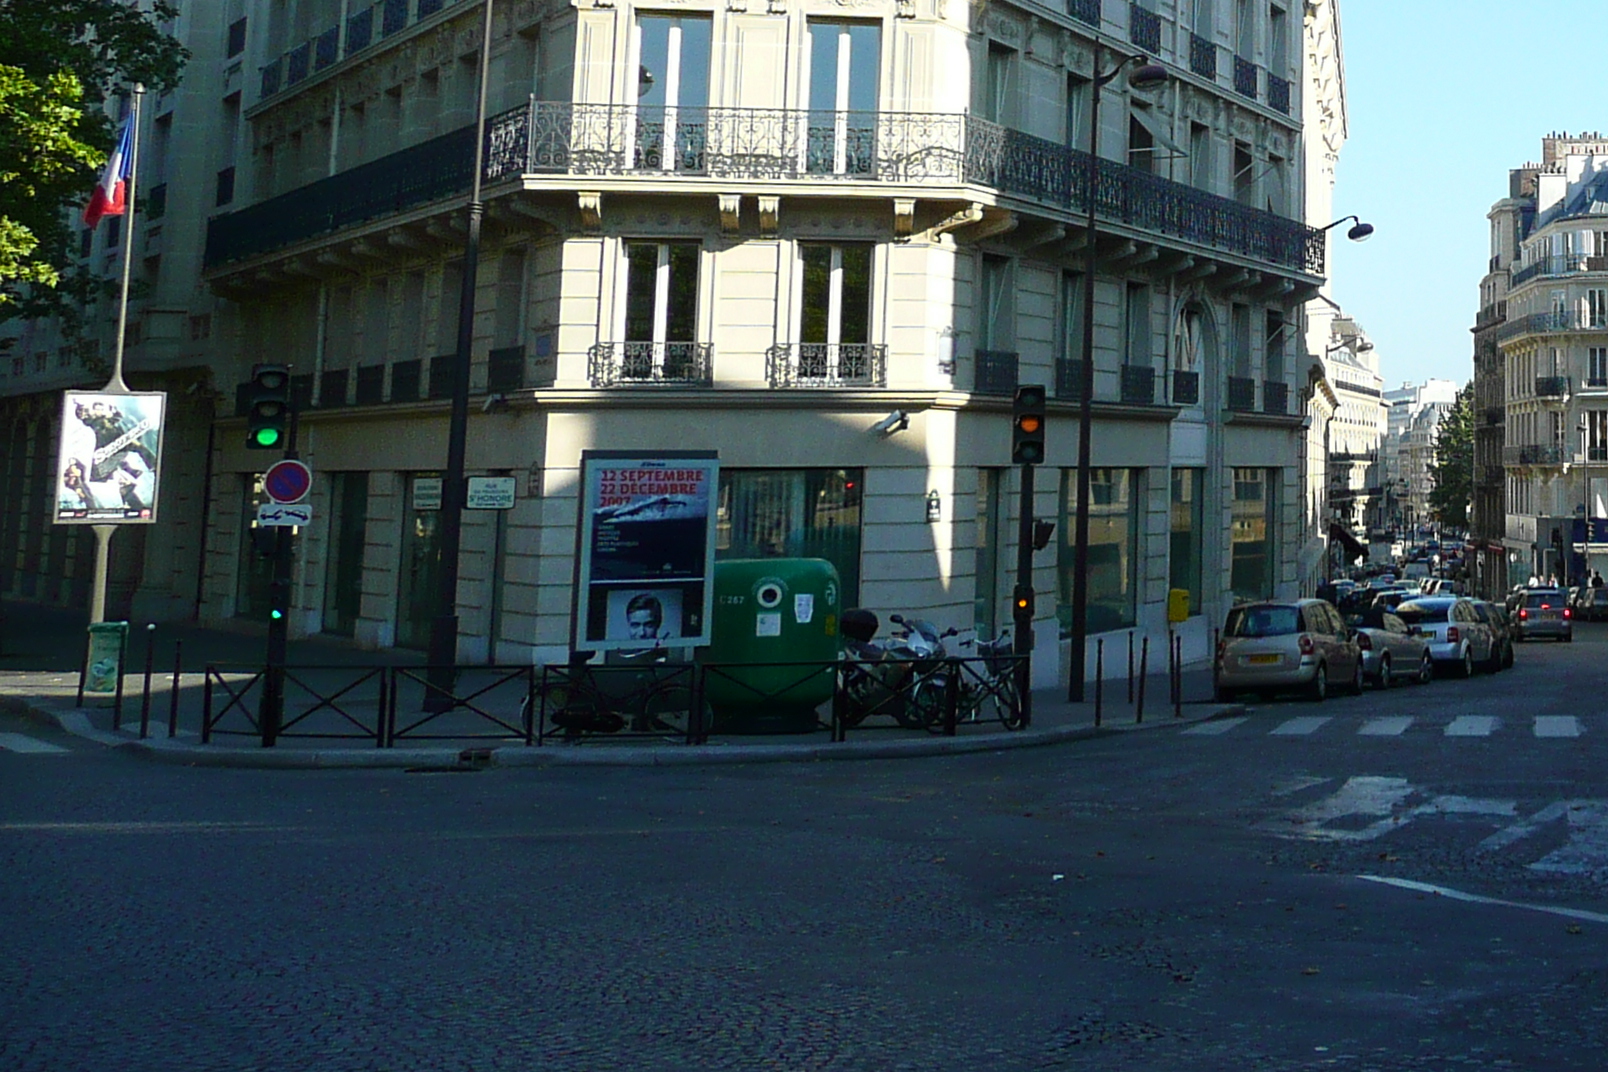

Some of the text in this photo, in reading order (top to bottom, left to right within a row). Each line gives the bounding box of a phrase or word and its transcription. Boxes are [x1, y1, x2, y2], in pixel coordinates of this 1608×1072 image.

[601, 469, 703, 482] 12 SEPTEMBRE
[600, 481, 697, 495] 22 DÉCEMBRE
[600, 496, 631, 508] 2007
